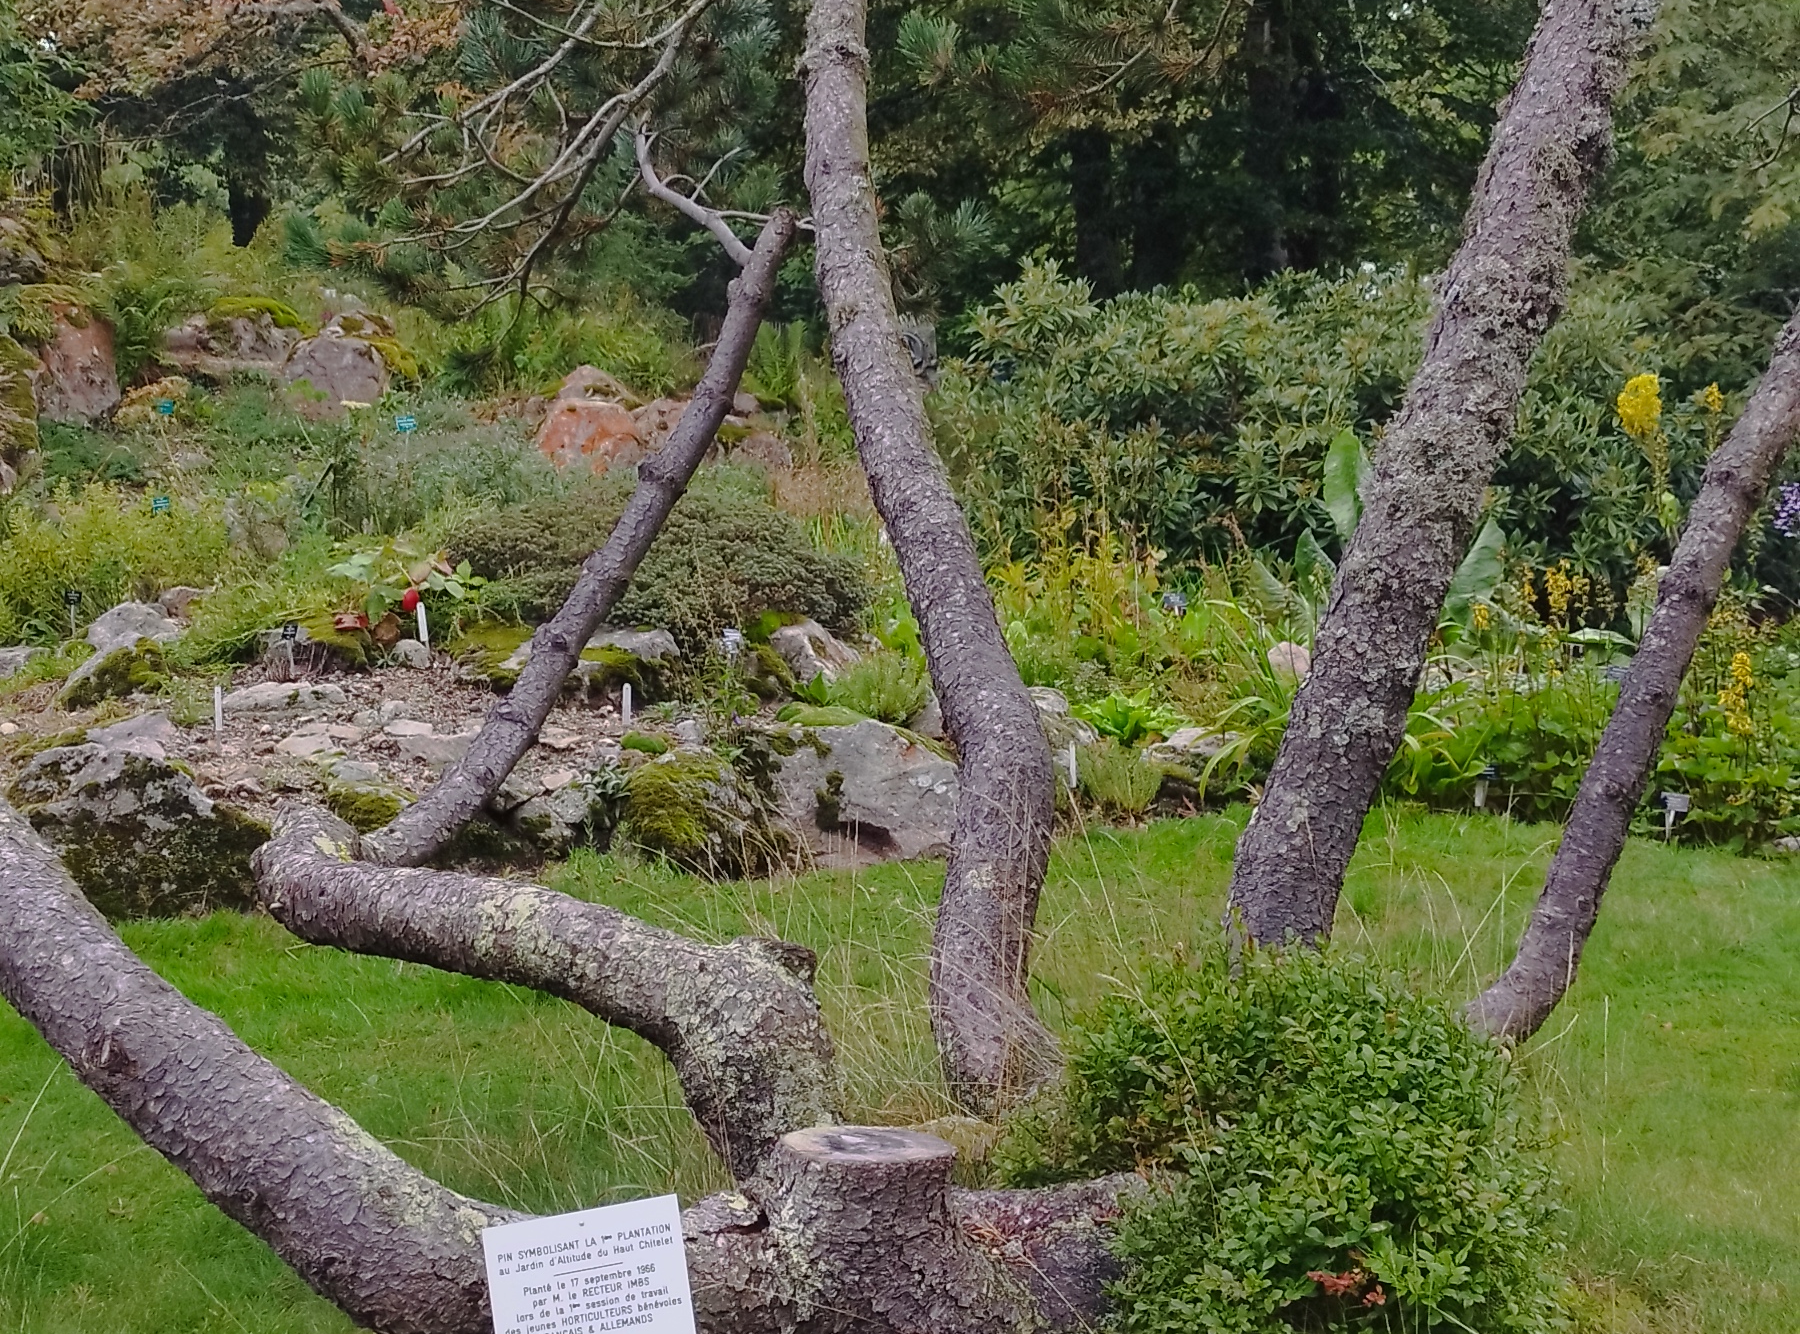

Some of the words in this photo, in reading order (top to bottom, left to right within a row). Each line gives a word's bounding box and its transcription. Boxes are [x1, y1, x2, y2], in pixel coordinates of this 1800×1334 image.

[497, 1252, 513, 1264] PIN
[518, 1239, 580, 1260] SYMBOLISANT
[585, 1237, 597, 1248] LA
[617, 1223, 671, 1241] PLANTATION
[499, 1267, 510, 1276] au
[515, 1261, 544, 1273] Jardin
[597, 1248, 608, 1258] du
[613, 1243, 634, 1255] Haut
[556, 1281, 566, 1290] le
[570, 1277, 579, 1287] 17
[584, 1269, 632, 1286] septembre
[516, 1313, 535, 1324] lors
[539, 1309, 551, 1319] de
[555, 1306, 565, 1316] la
[585, 1296, 620, 1310] session
[625, 1293, 636, 1303] de
[641, 1285, 669, 1299] travail
[532, 1298, 547, 1310] par
[552, 1293, 564, 1304] M.
[568, 1291, 577, 1301] le
[582, 1281, 623, 1298] RECTEUR
[561, 1304, 633, 1327] HORTICULTEURS
[588, 1325, 595, 1334] &
[600, 1312, 654, 1332] ALLEMANDS
